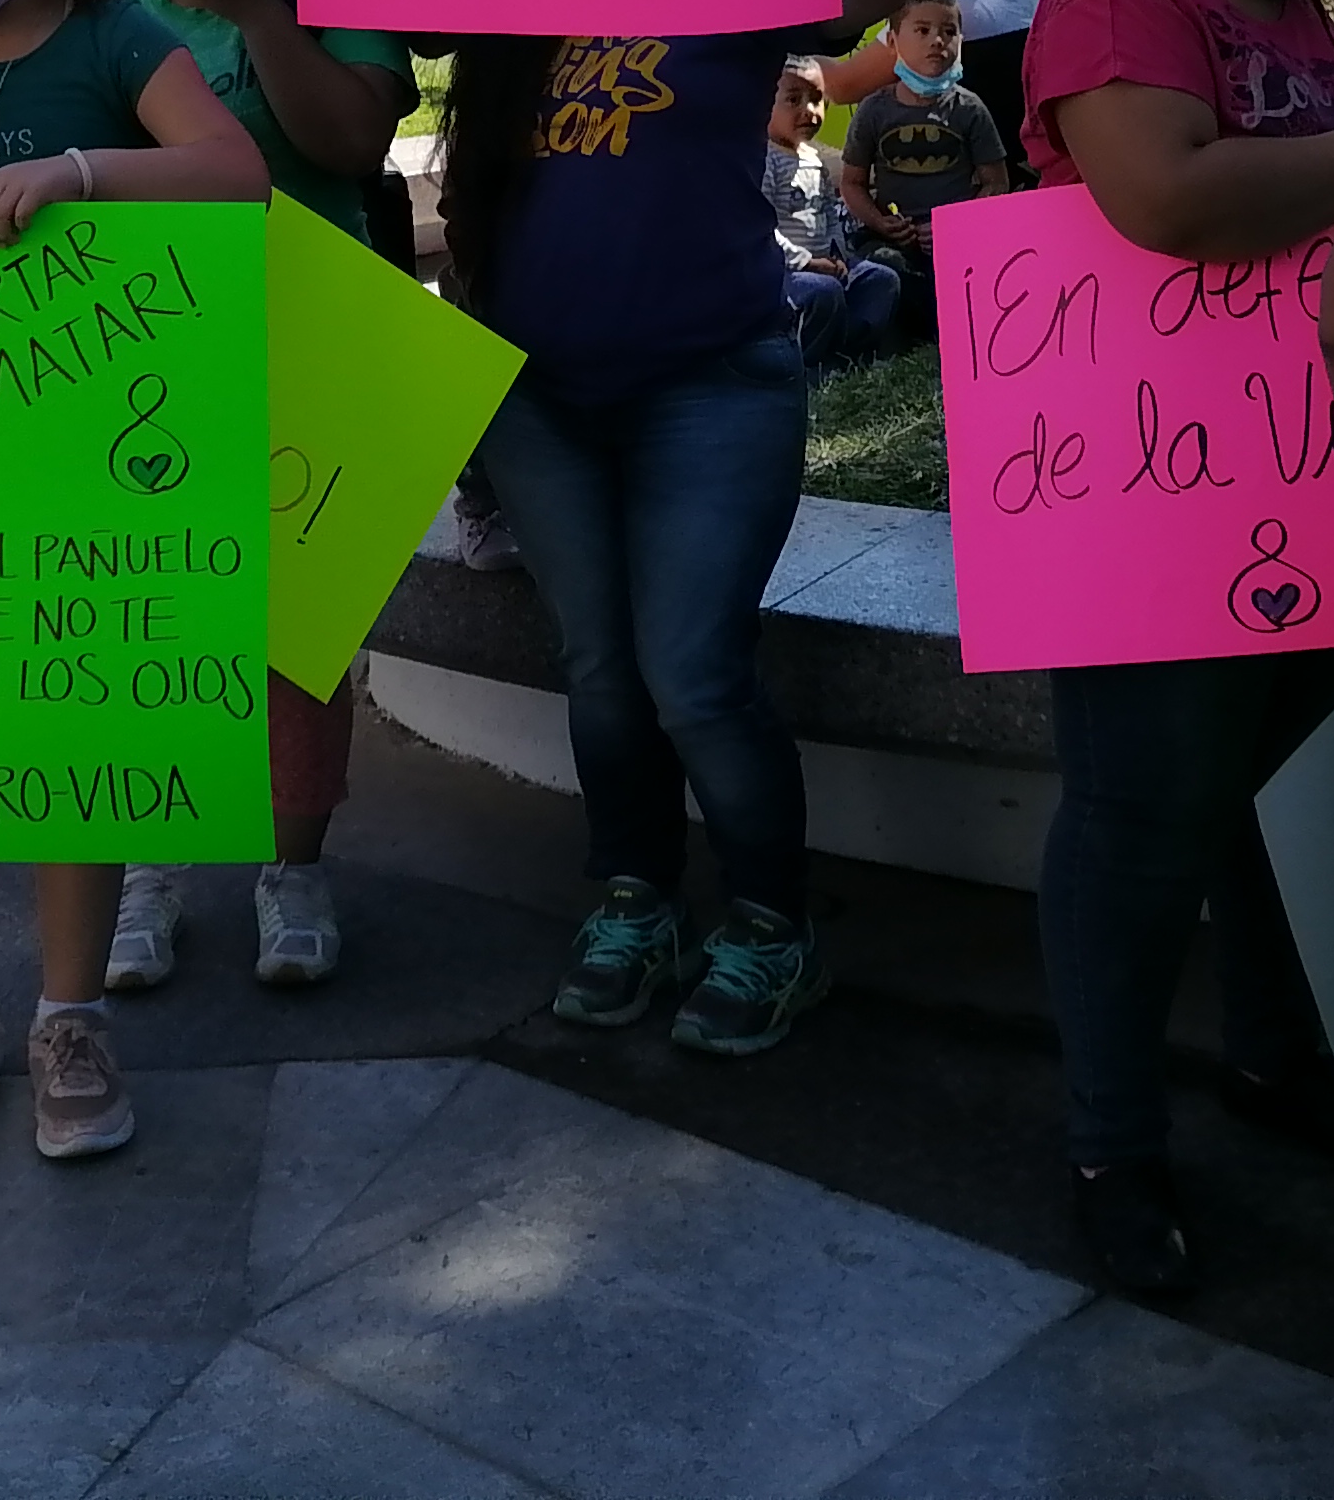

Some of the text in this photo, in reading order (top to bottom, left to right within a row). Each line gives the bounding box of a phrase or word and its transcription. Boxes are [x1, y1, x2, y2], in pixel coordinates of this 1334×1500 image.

[964, 248, 1100, 381] ¡En
[992, 411, 1091, 516] de
[1122, 378, 1235, 496] la
[33, 527, 243, 581] PAÑUELO
[33, 595, 97, 644] NO
[110, 596, 181, 644] TE
[19, 652, 110, 706] LOS
[131, 654, 255, 721] OJOS
